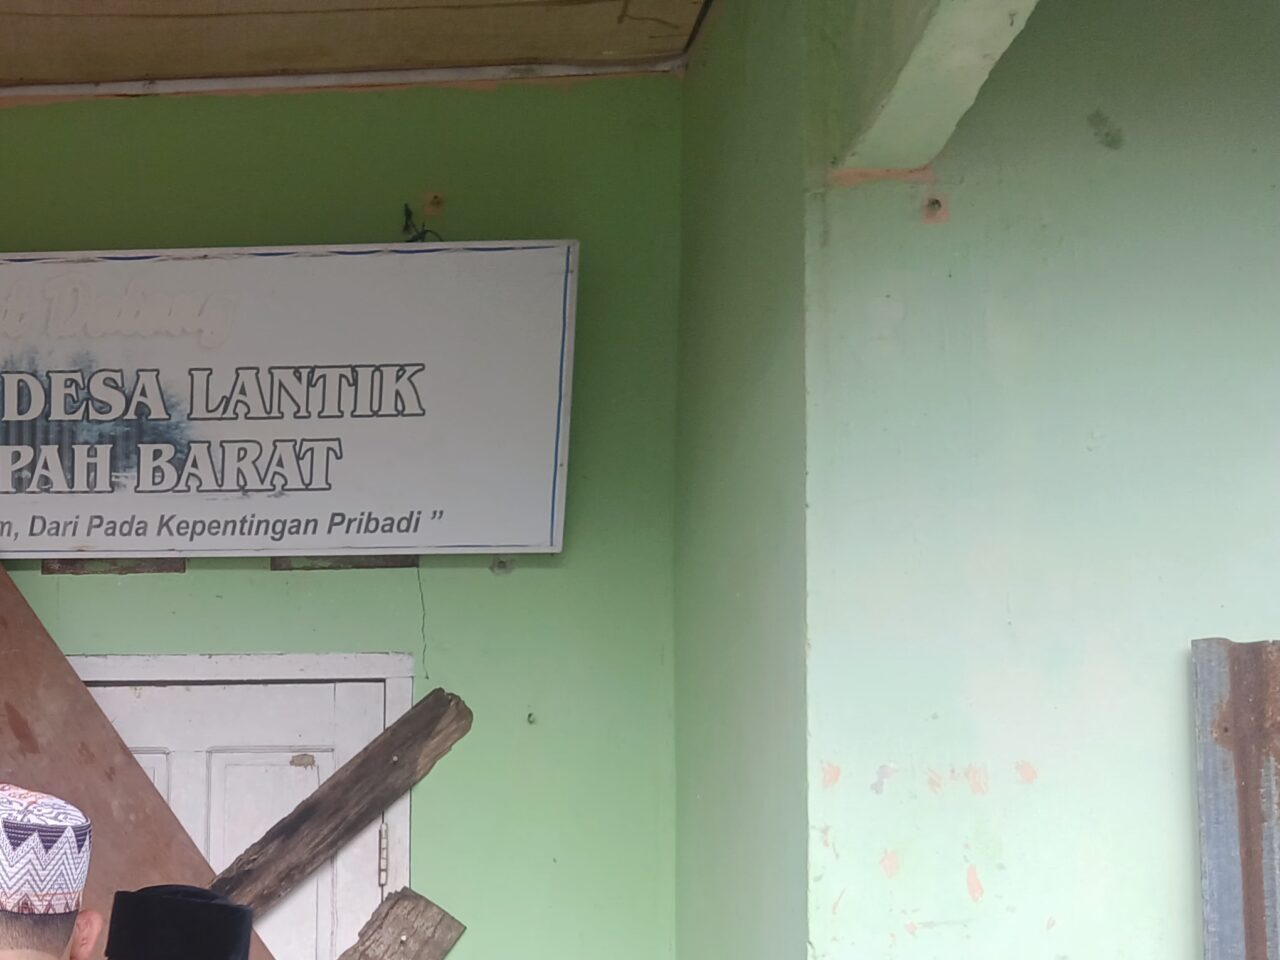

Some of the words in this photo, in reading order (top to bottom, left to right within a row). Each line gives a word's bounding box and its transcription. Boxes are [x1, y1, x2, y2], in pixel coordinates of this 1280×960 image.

[1, 369, 170, 422] DESA
[187, 363, 425, 419] LANTIK
[134, 437, 343, 492] BARAT
[28, 515, 79, 537] Dari
[86, 514, 148, 537] Pada
[156, 513, 319, 542] Kepentingan
[326, 510, 422, 535] Pribadi
